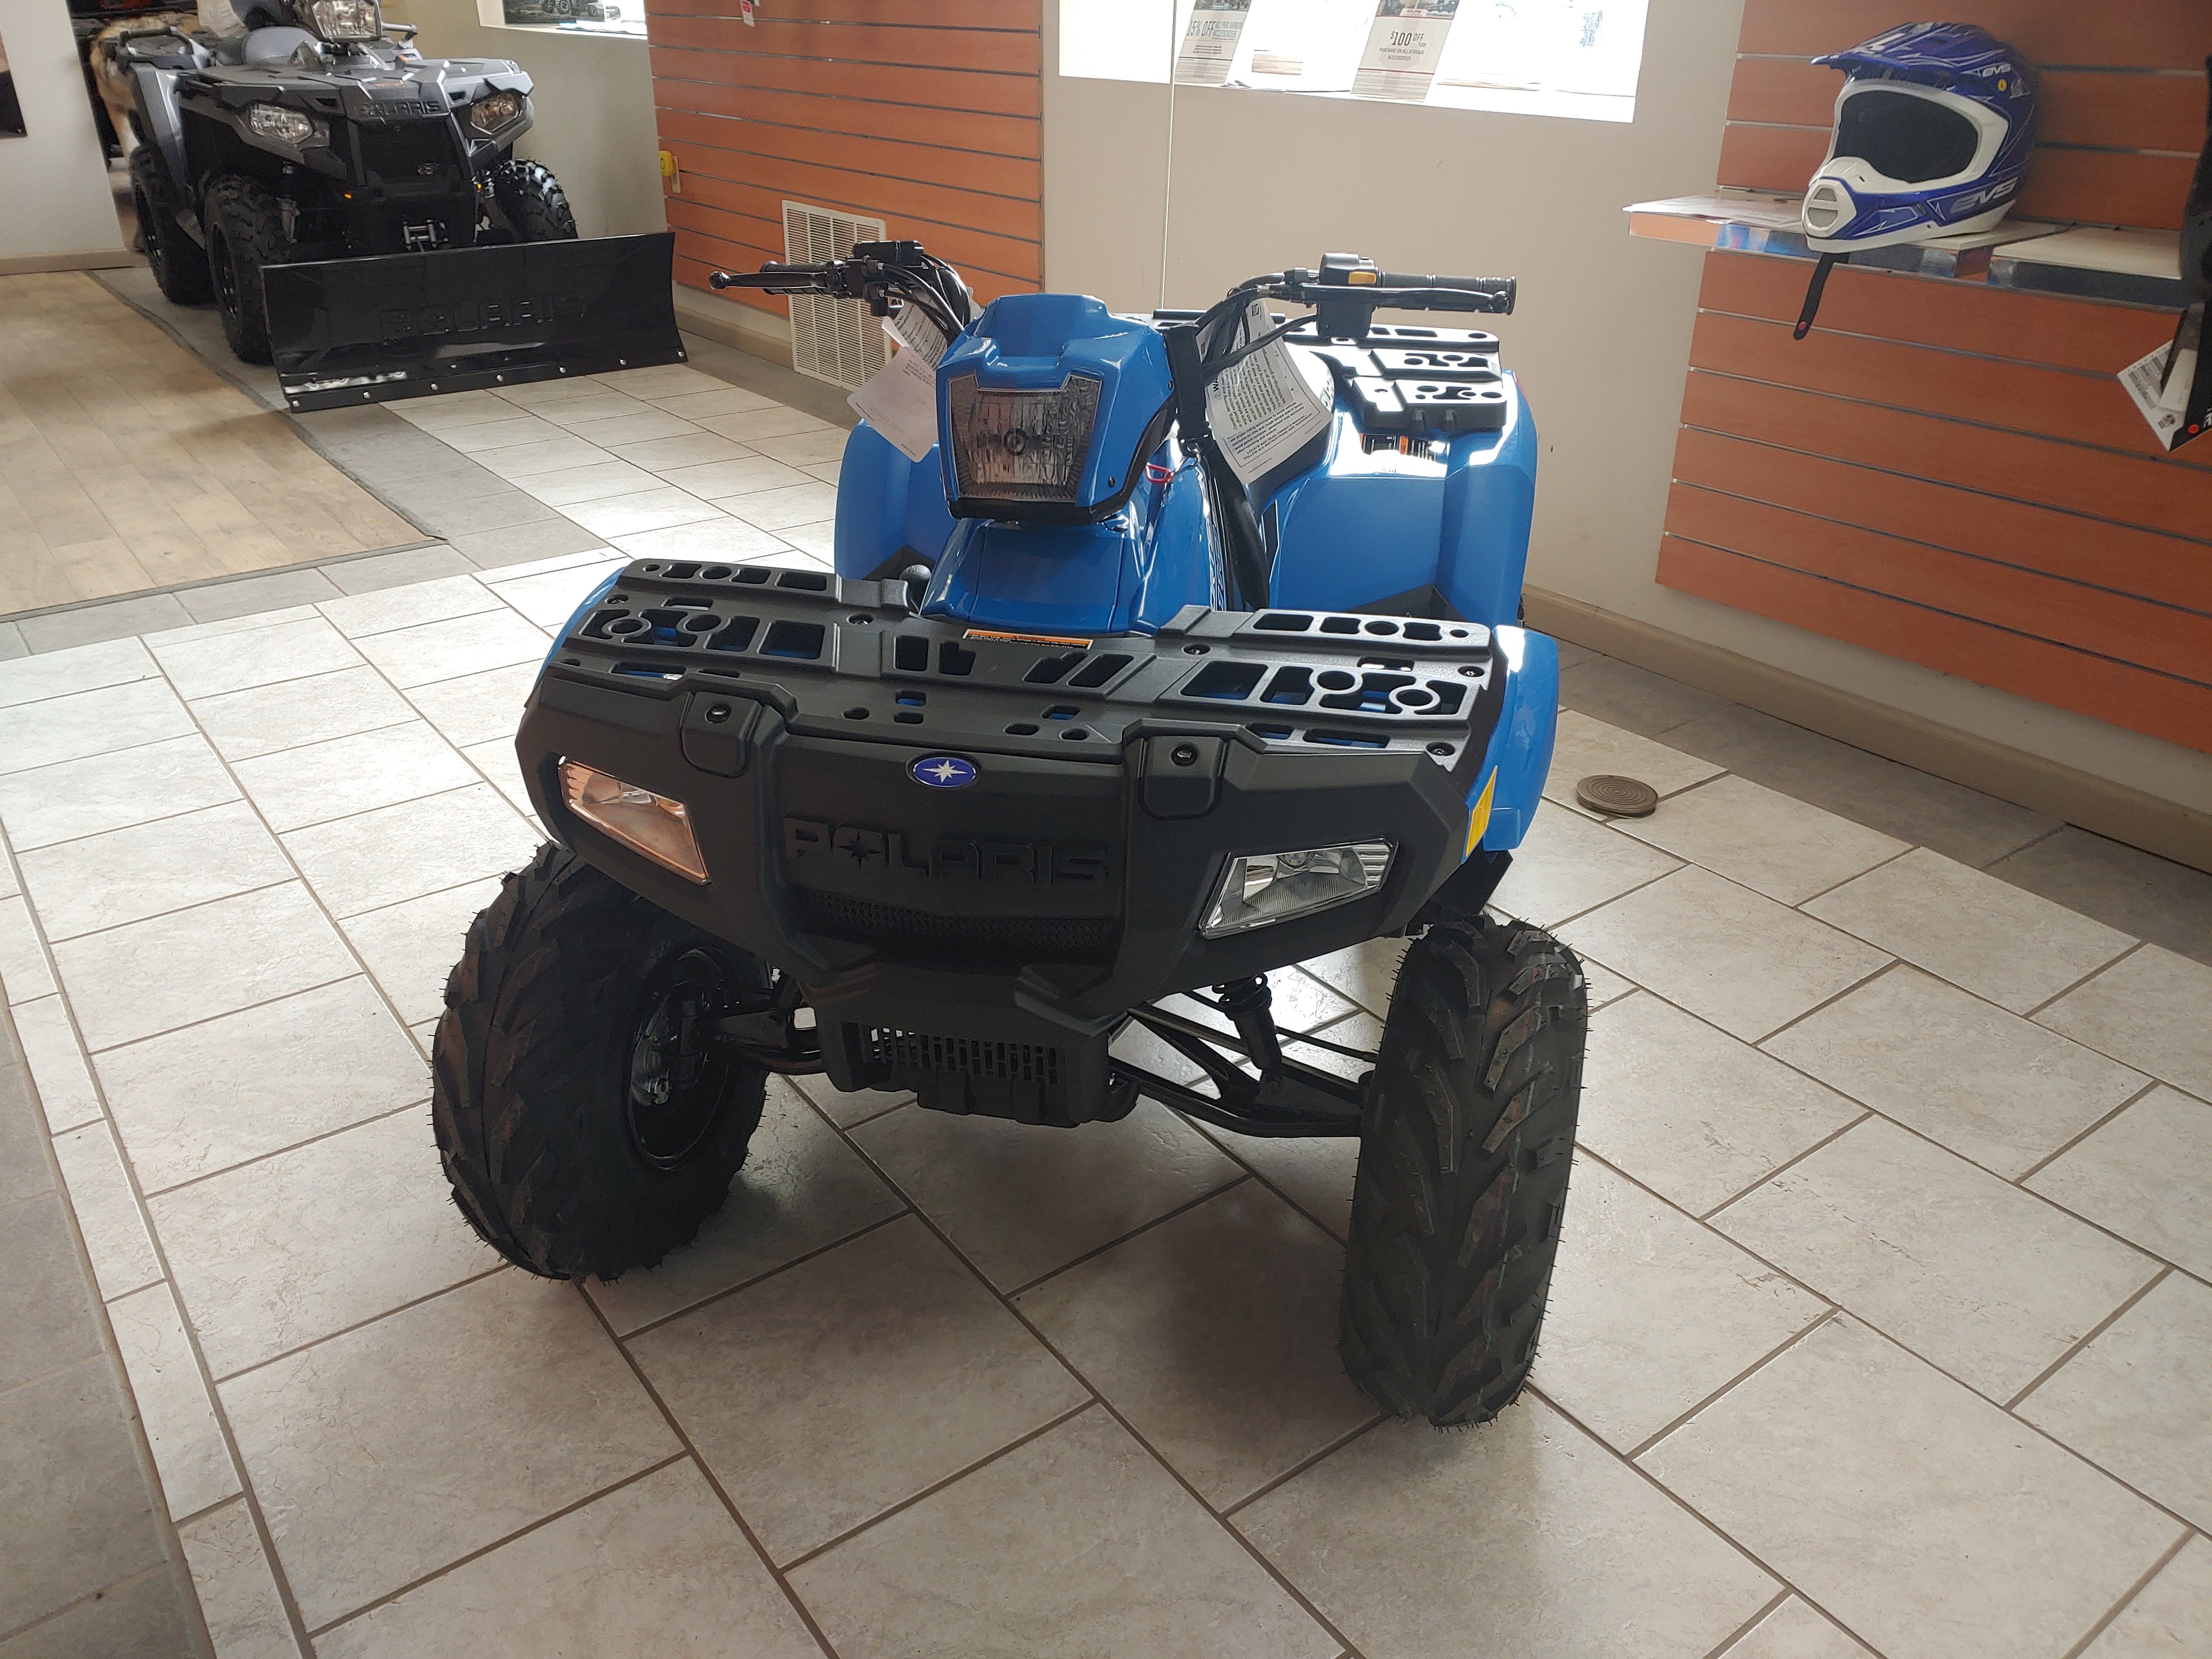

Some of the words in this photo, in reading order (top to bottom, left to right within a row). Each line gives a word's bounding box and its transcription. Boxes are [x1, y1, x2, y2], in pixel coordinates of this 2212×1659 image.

[1186, 20, 1202, 36] 15%
[1201, 21, 1216, 37] OFF
[1390, 31, 1412, 46] $100
[1413, 33, 1425, 41] OFF
[782, 815, 1108, 885] POLARIS
